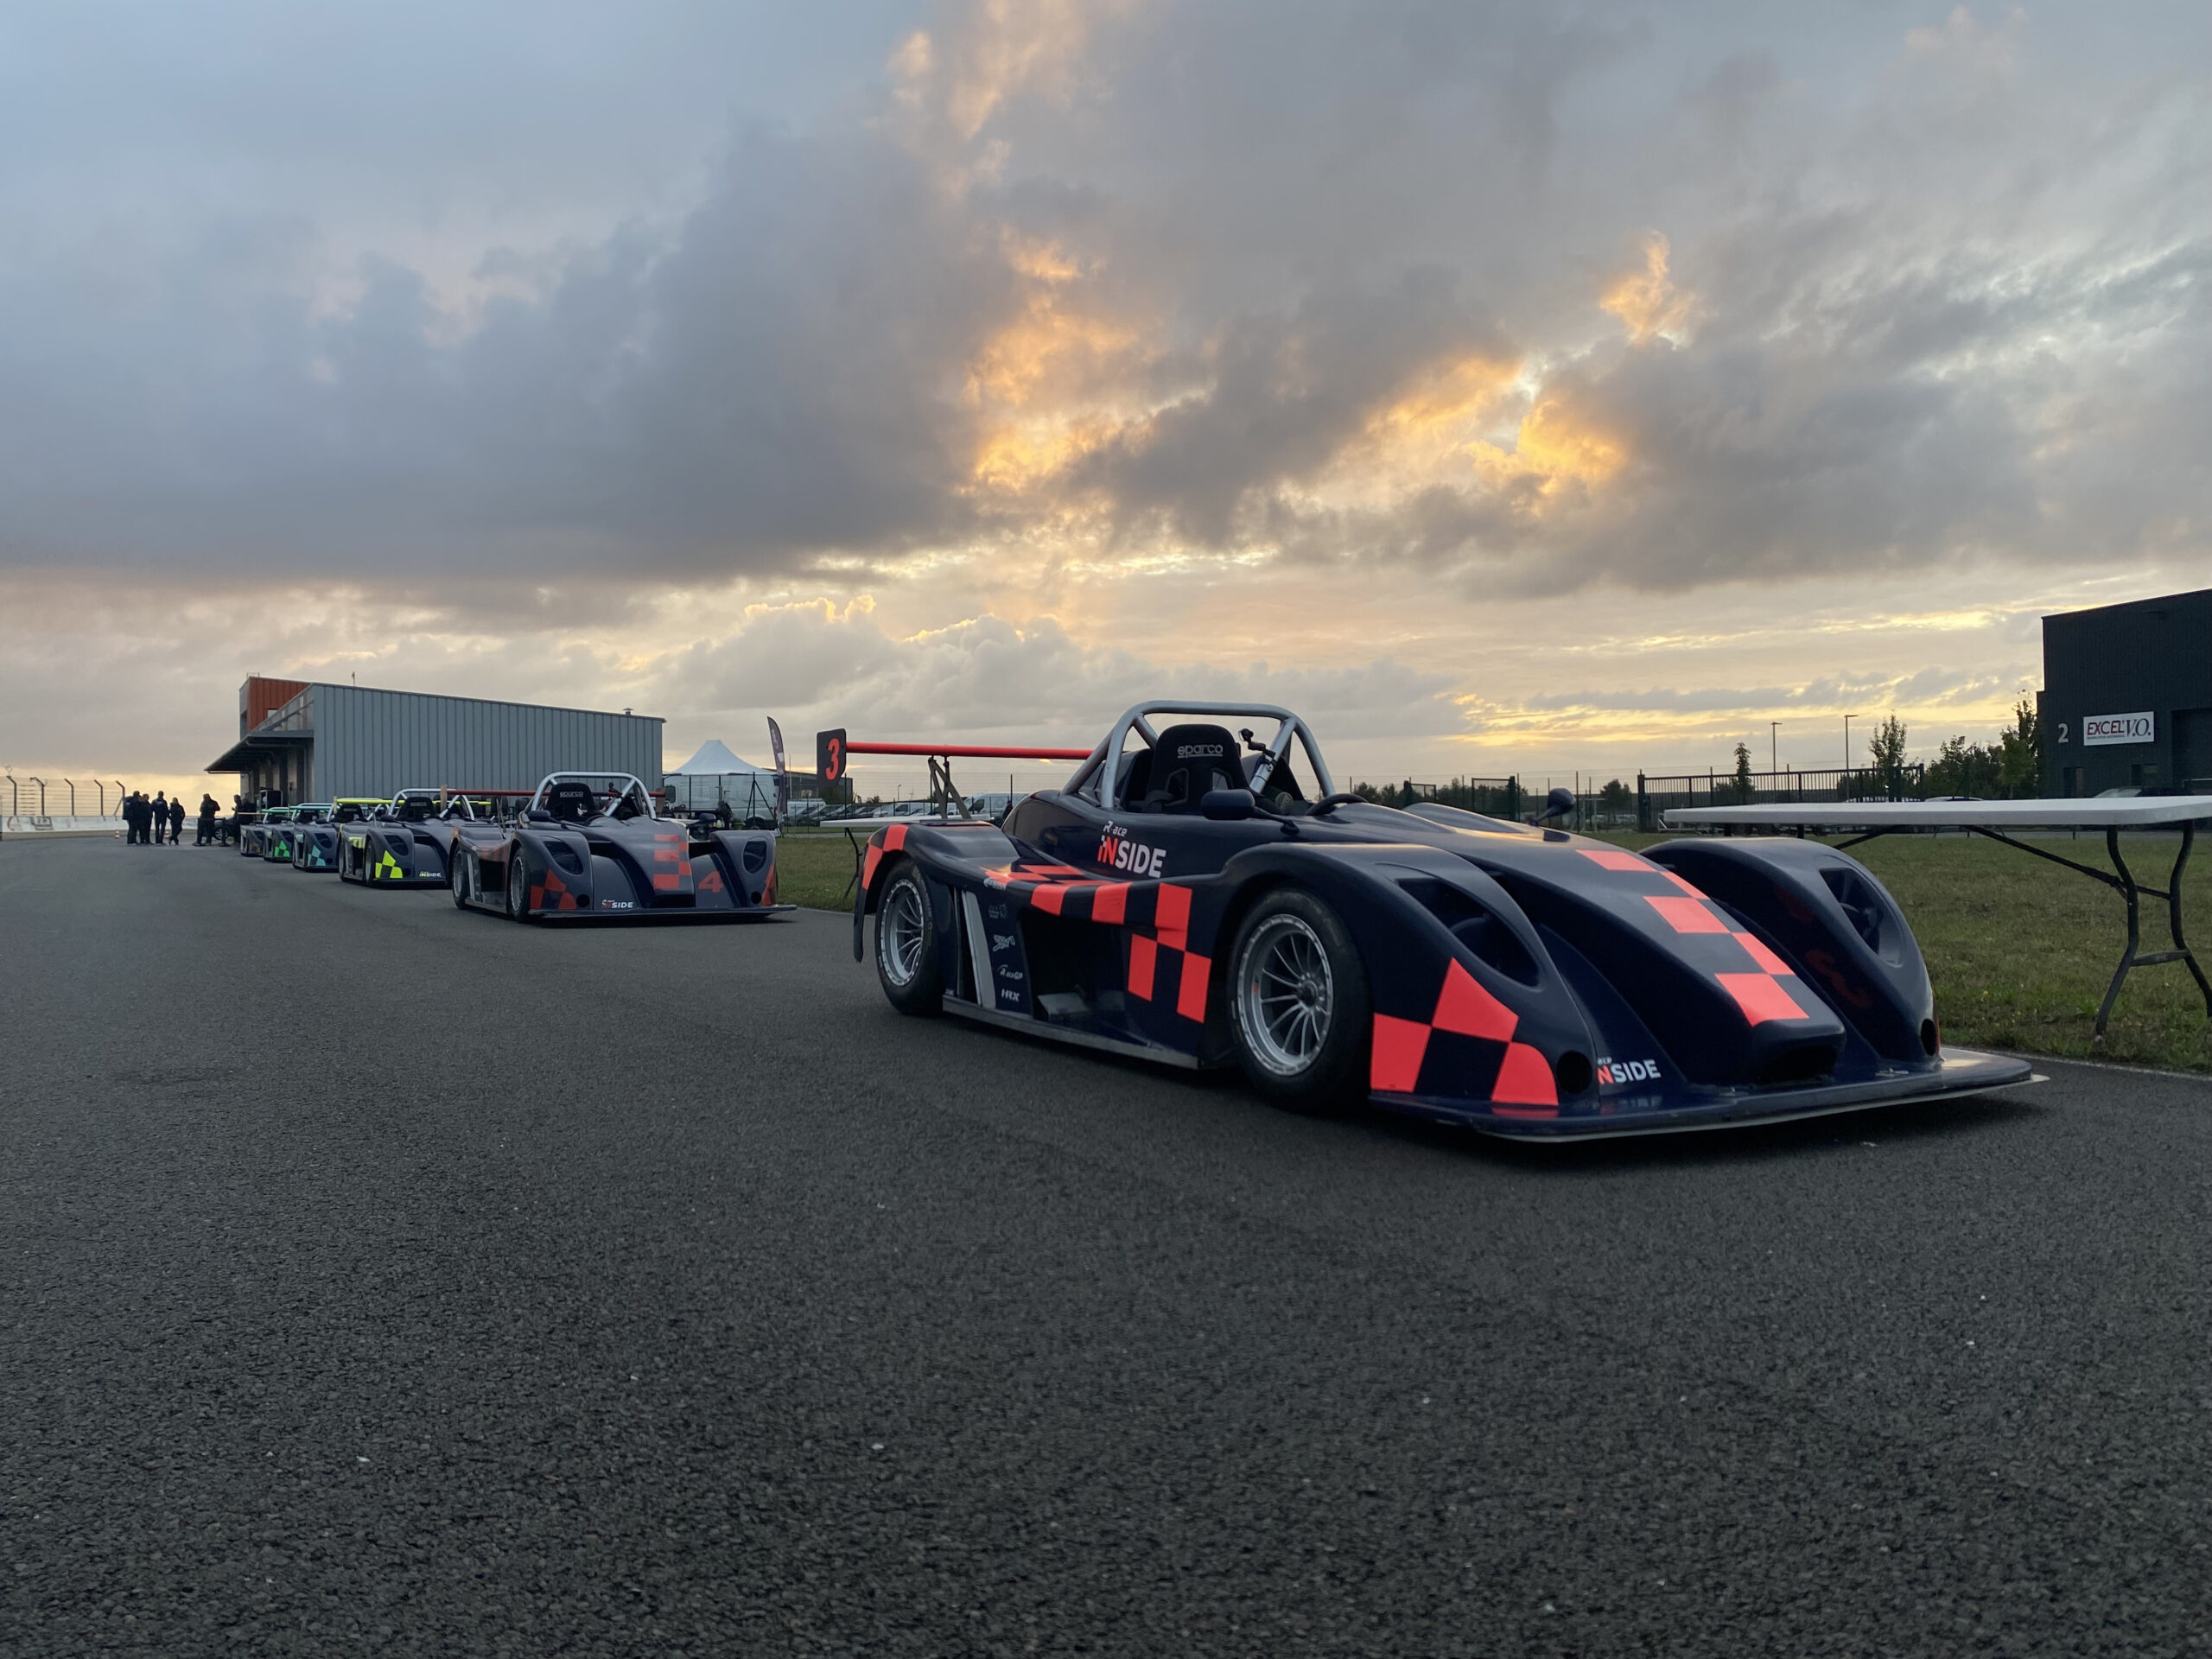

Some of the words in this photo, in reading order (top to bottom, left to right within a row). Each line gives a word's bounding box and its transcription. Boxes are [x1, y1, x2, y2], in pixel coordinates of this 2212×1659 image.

[2058, 723, 2069, 743] 2
[825, 738, 840, 780] 3
[697, 870, 724, 893] 4
[1597, 1059, 1662, 1085] NSIDE
